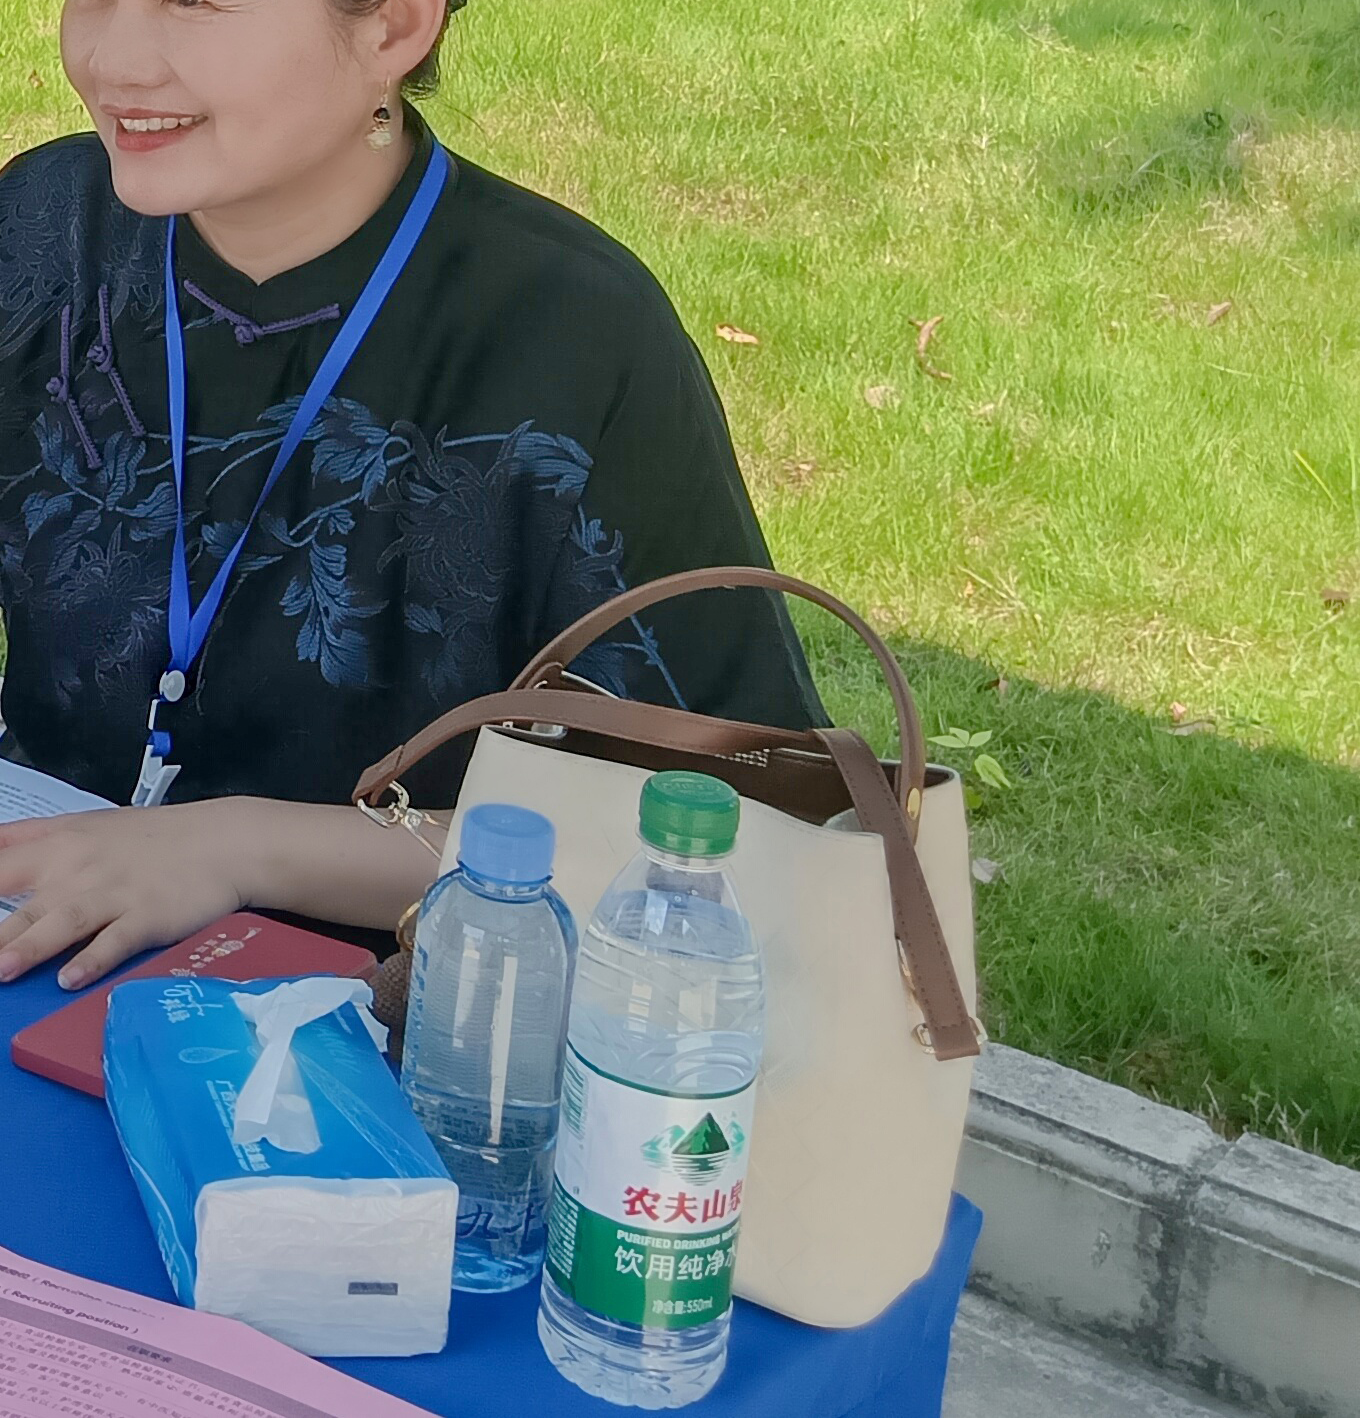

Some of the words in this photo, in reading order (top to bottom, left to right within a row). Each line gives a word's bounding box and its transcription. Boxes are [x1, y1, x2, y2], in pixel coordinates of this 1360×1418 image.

[622, 1179, 744, 1224] 农夫山泉
[617, 1229, 671, 1249] PURIFIED
[673, 1233, 720, 1250] DRINKING
